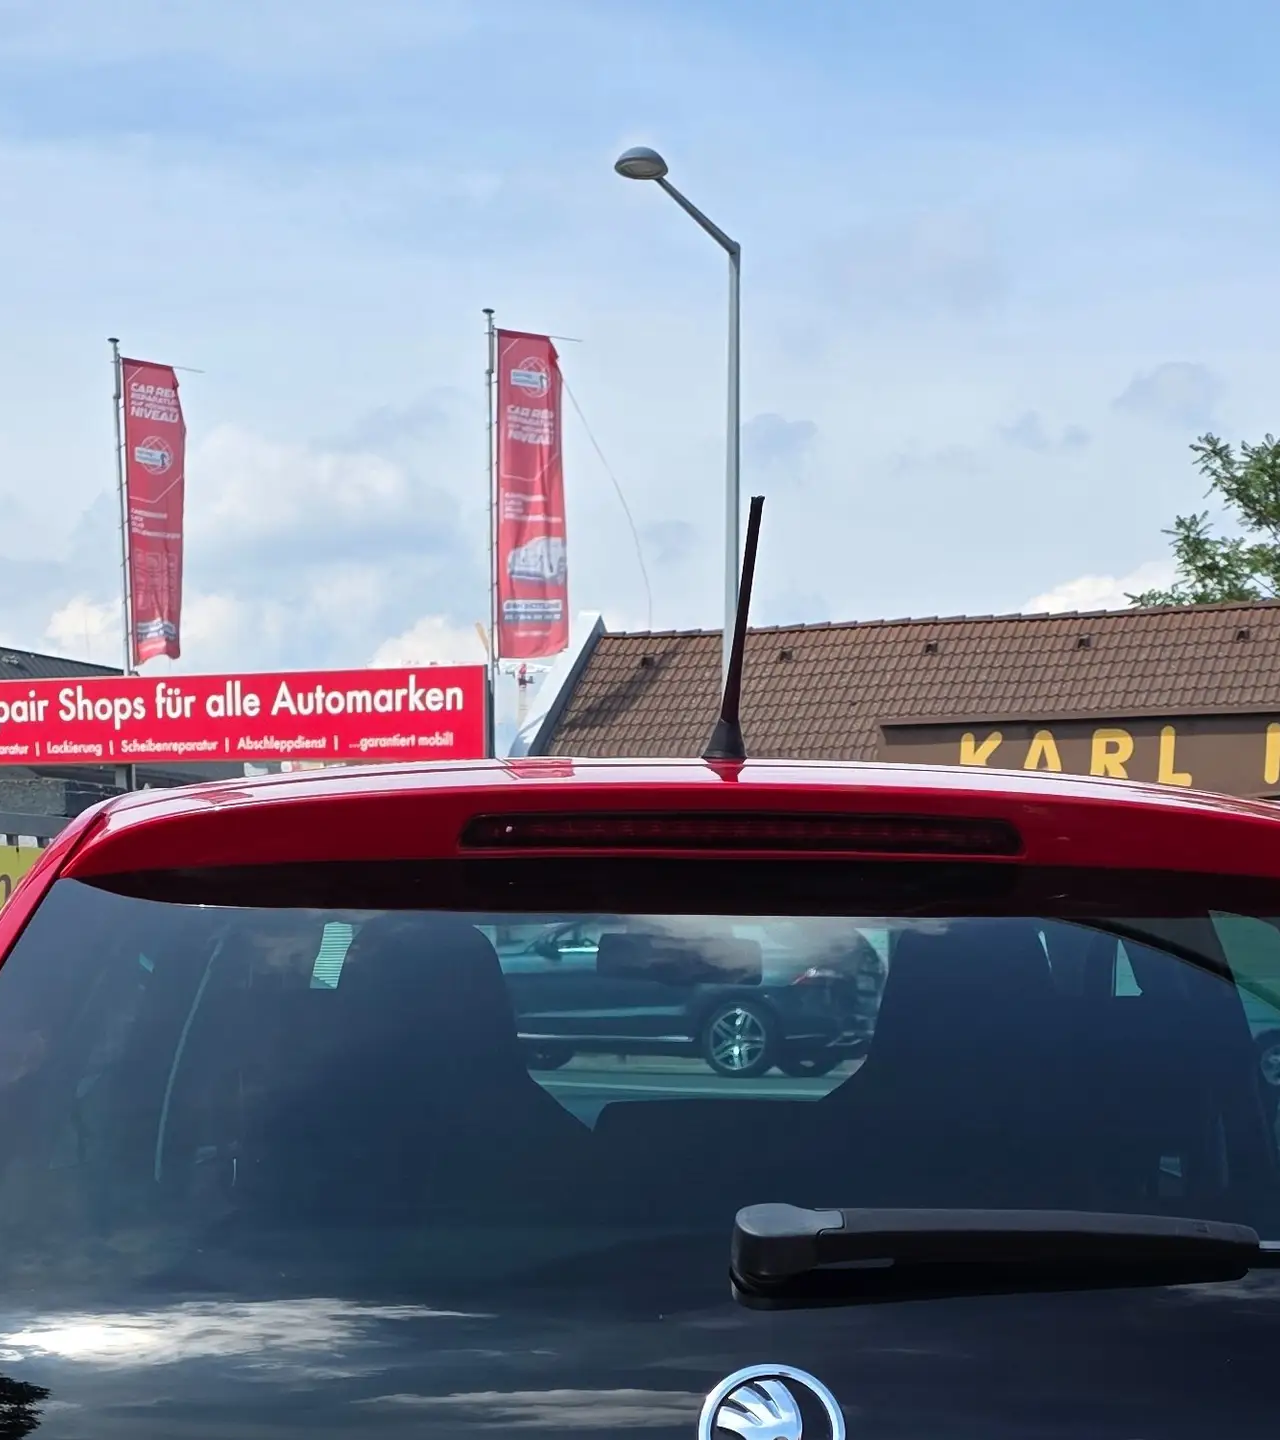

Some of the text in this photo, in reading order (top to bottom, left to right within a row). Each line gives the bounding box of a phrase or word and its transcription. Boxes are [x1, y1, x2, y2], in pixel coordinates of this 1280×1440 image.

[58, 685, 146, 730] Shops
[155, 683, 196, 719] für
[205, 680, 261, 718] alle
[271, 673, 463, 716] Automarken
[46, 741, 102, 757] Lackierung
[120, 738, 218, 753] Scheibenreparatur
[237, 735, 327, 752] Abschleppdienst
[959, 725, 1193, 787] KARL
